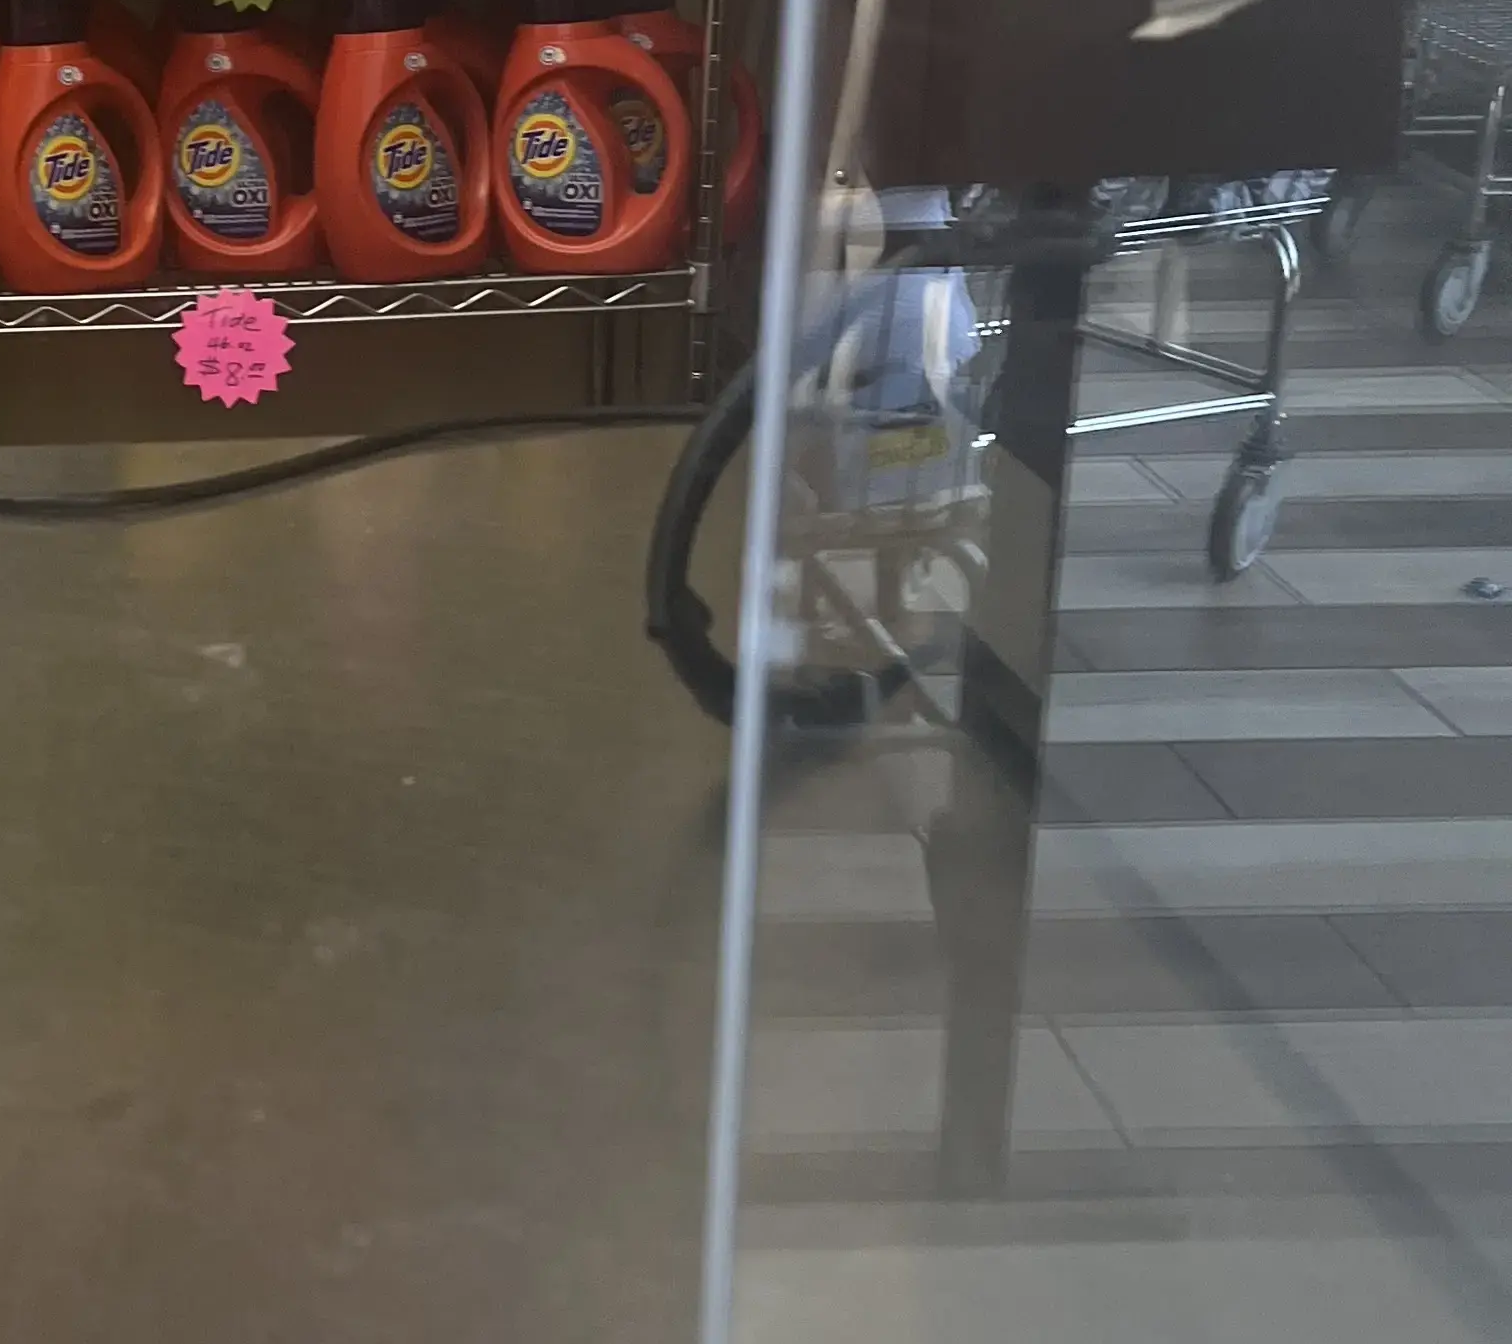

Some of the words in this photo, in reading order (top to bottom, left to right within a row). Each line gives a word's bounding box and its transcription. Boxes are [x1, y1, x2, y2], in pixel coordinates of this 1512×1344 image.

[187, 140, 234, 176] Tide
[383, 142, 430, 178] Tide
[520, 130, 569, 165] Tide
[44, 151, 91, 189] Tide
[234, 190, 269, 206] OXI
[564, 183, 601, 201] OXI
[199, 306, 262, 333] Tide
